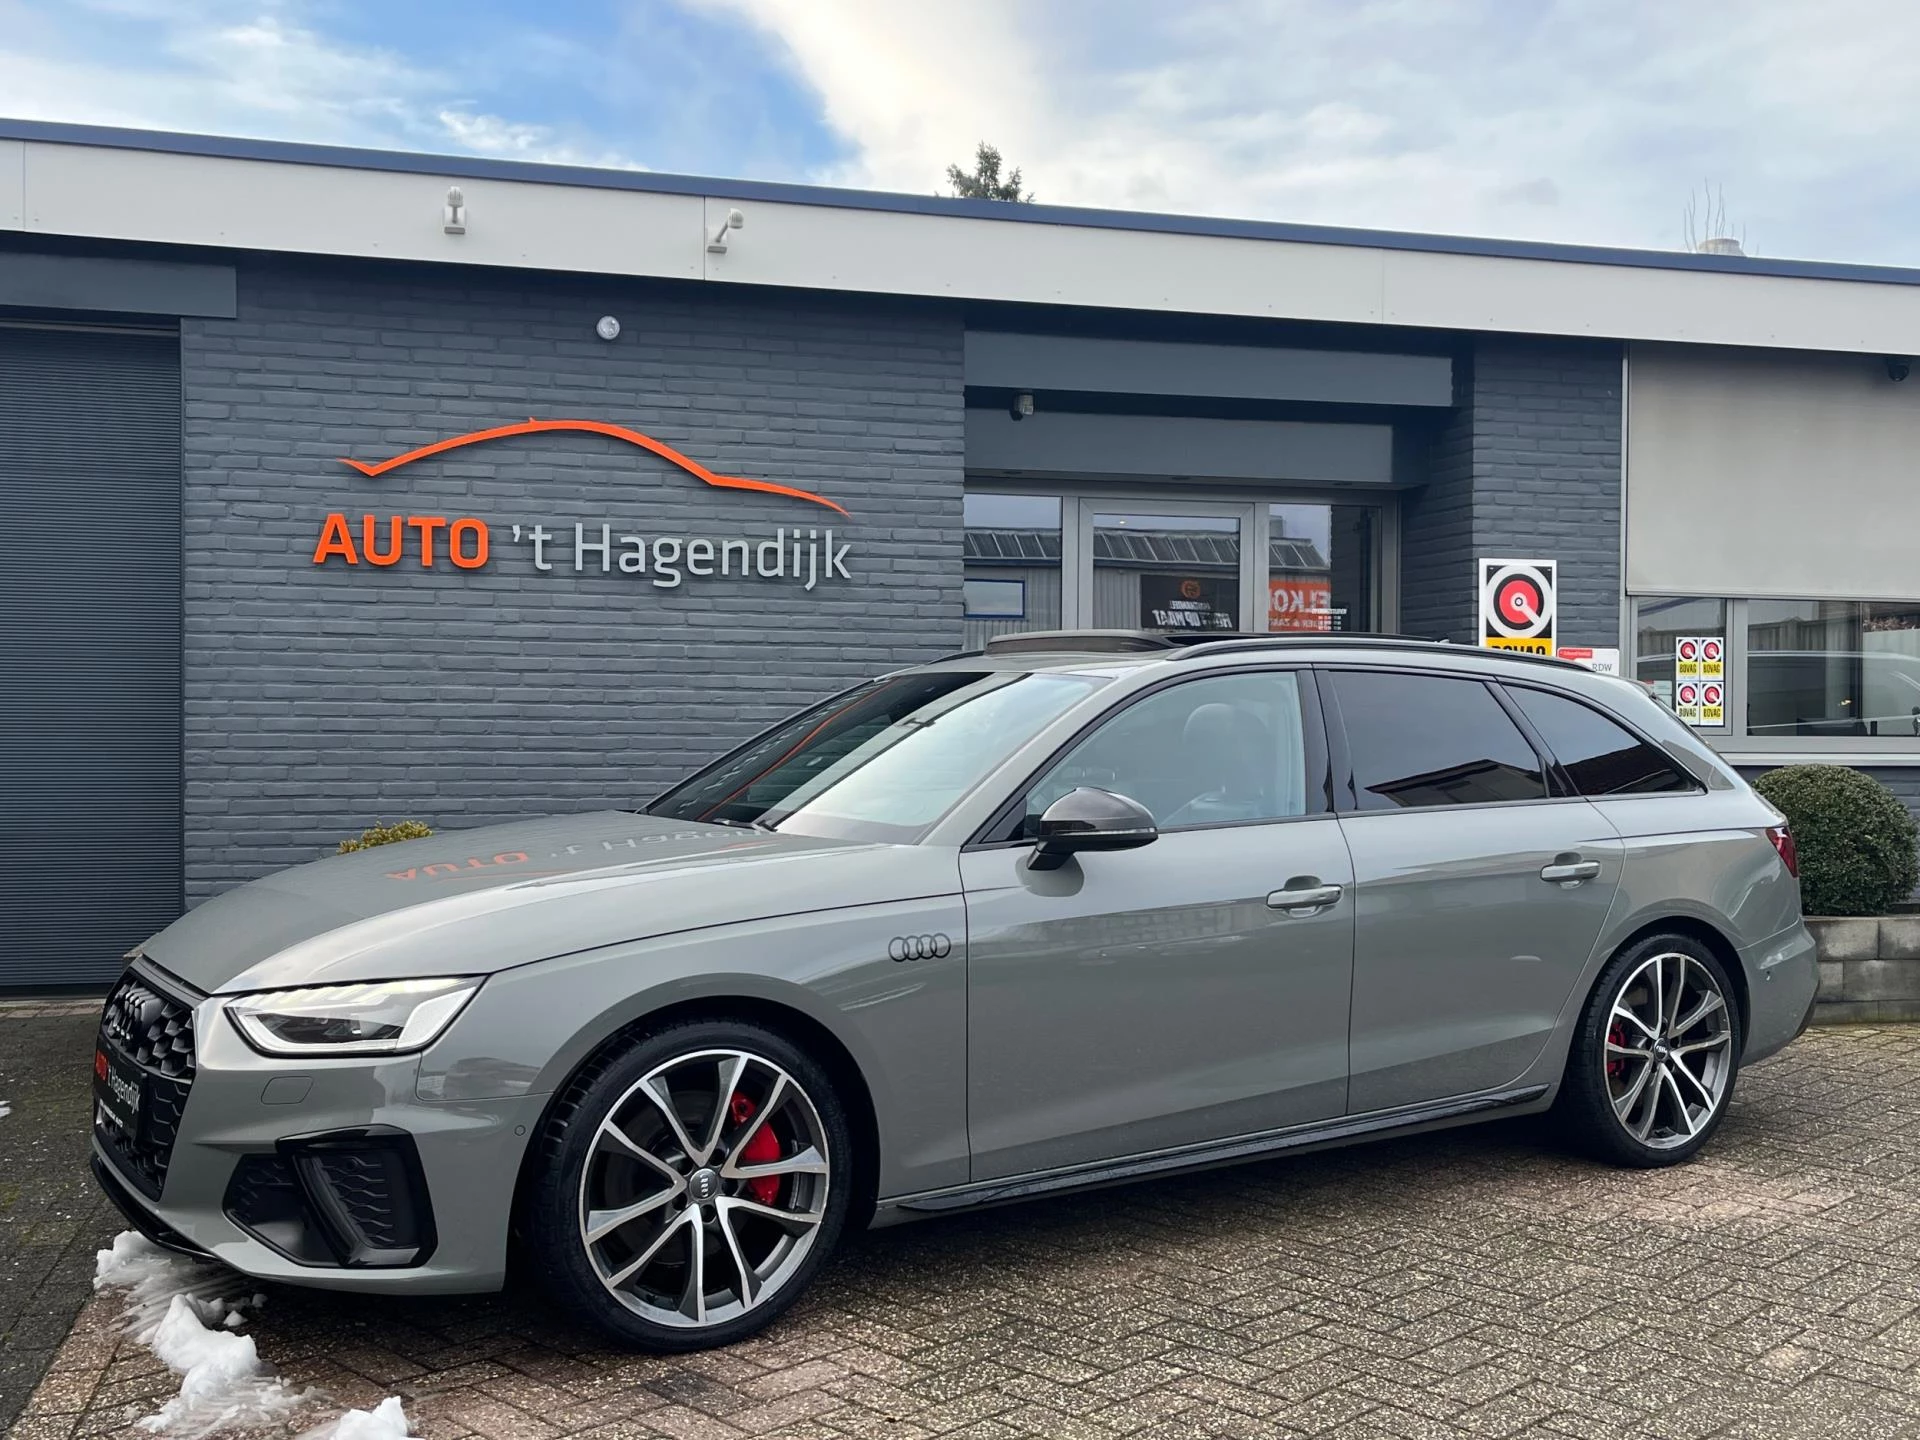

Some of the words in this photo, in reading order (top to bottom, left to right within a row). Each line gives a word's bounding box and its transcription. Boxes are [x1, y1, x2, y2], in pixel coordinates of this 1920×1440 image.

[313, 513, 490, 569] AUTO
[511, 523, 553, 571] 't
[574, 522, 853, 592] Hagendijk
[1592, 663, 1612, 672] RDW
[1679, 663, 1697, 674] BOVAG
[1703, 663, 1721, 674] BOVAG
[1679, 707, 1697, 718] BOVAG
[1703, 707, 1721, 718] BOVAG
